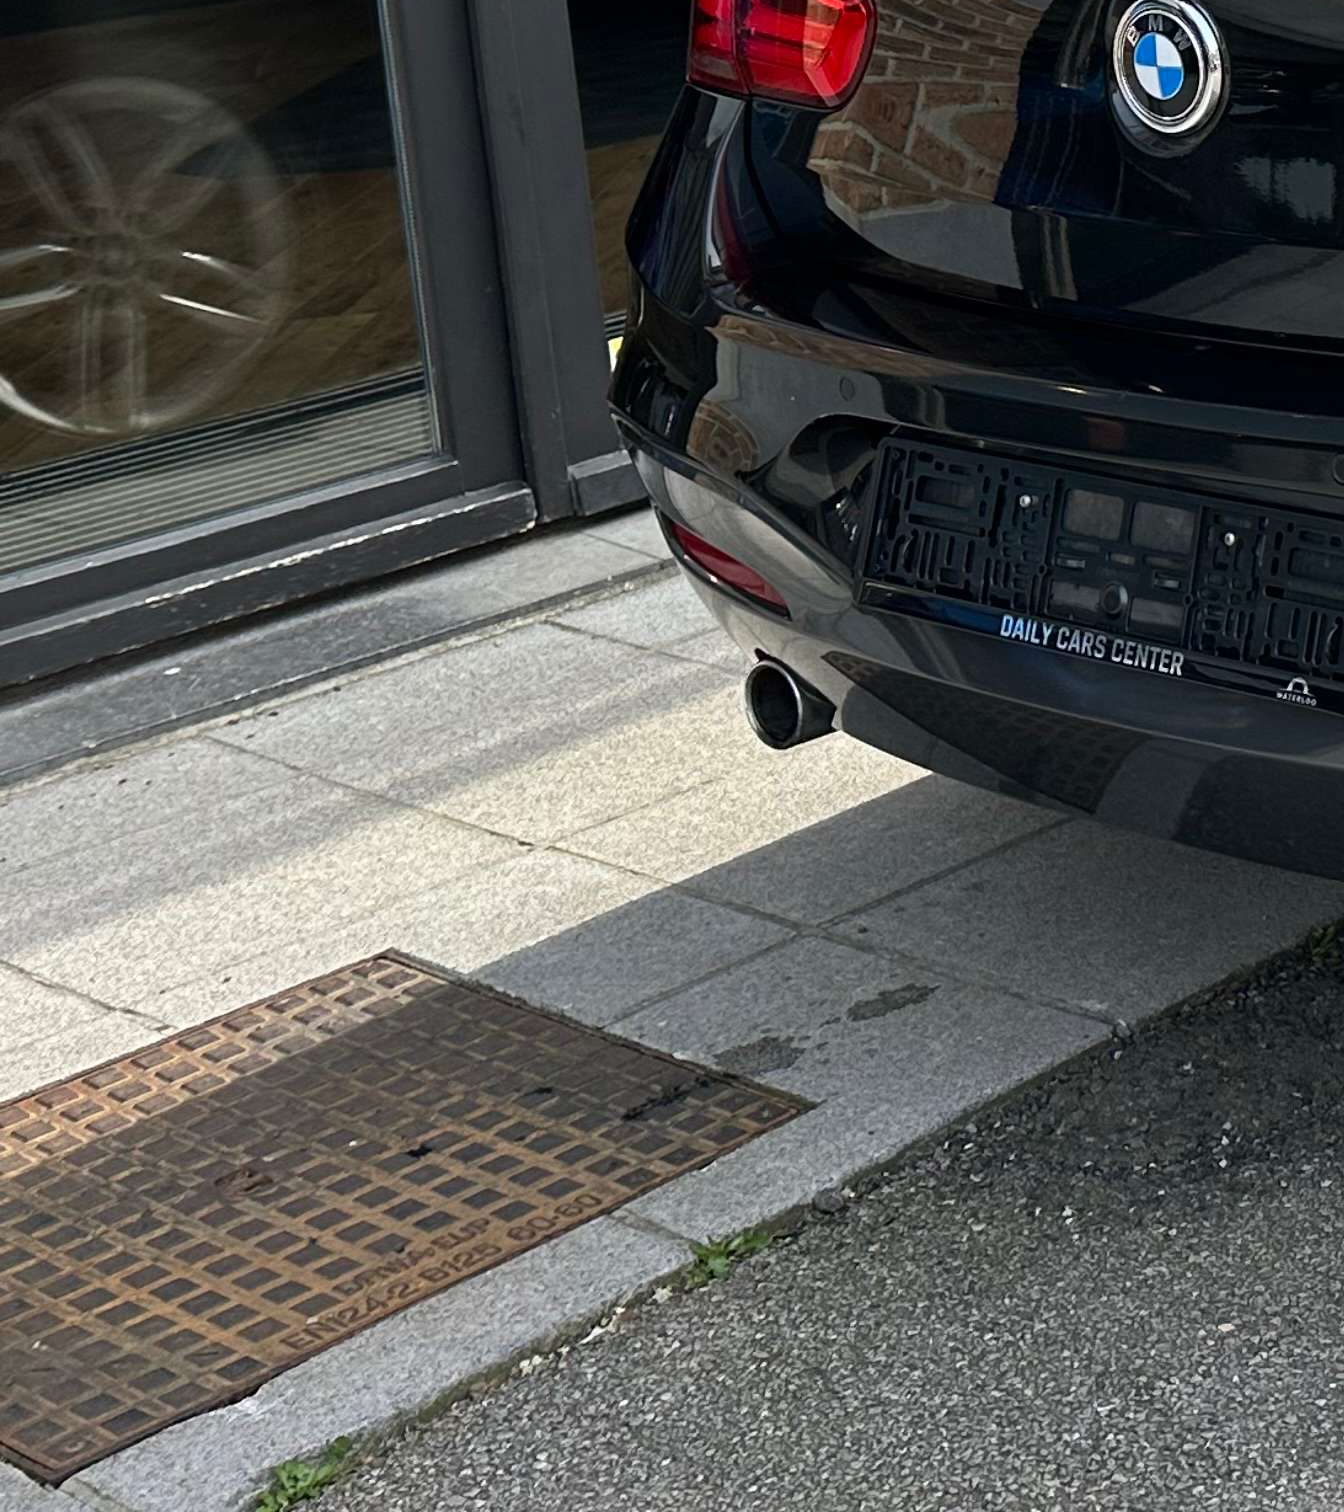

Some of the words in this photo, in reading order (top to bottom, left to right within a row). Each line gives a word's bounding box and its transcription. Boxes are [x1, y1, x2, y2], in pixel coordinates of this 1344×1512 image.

[1000, 614, 1055, 647] DAILY
[1056, 626, 1107, 659] CARS
[1111, 639, 1185, 676] CENTER
